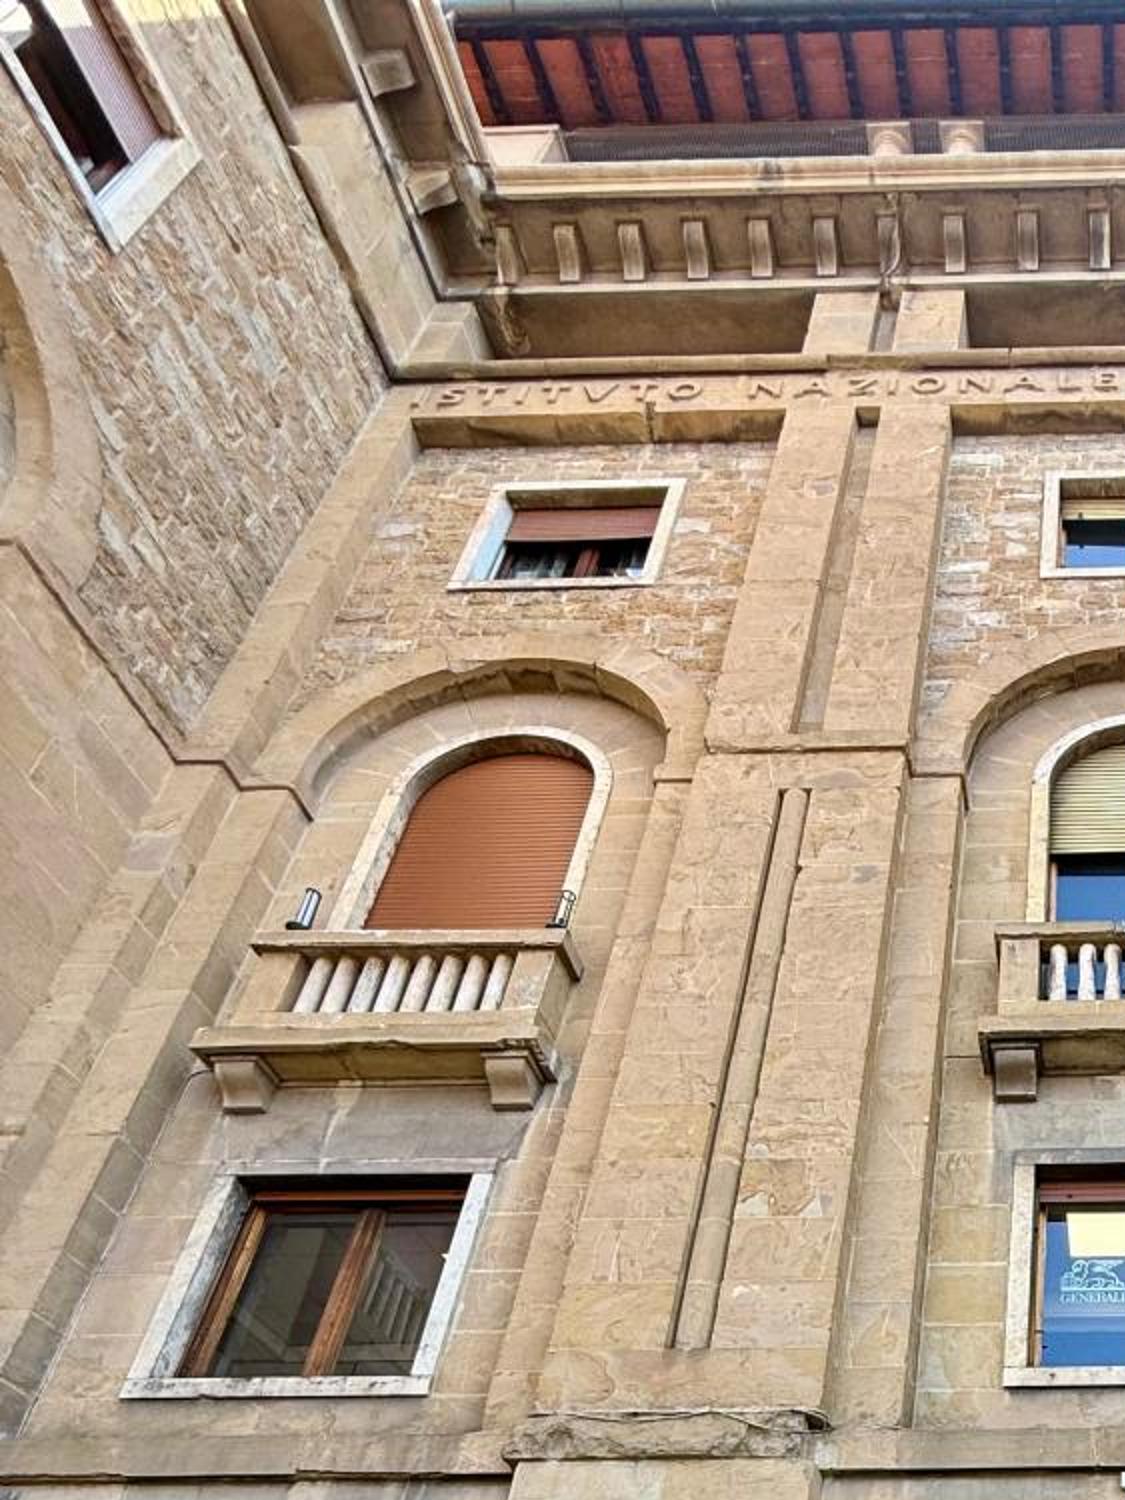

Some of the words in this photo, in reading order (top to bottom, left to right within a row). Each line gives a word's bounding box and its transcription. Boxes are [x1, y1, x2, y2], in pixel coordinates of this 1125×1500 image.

[410, 382, 702, 410] ISTITVTO
[748, 371, 1121, 399] NAZIONALE
[1059, 1291, 1125, 1303] GENERALI
